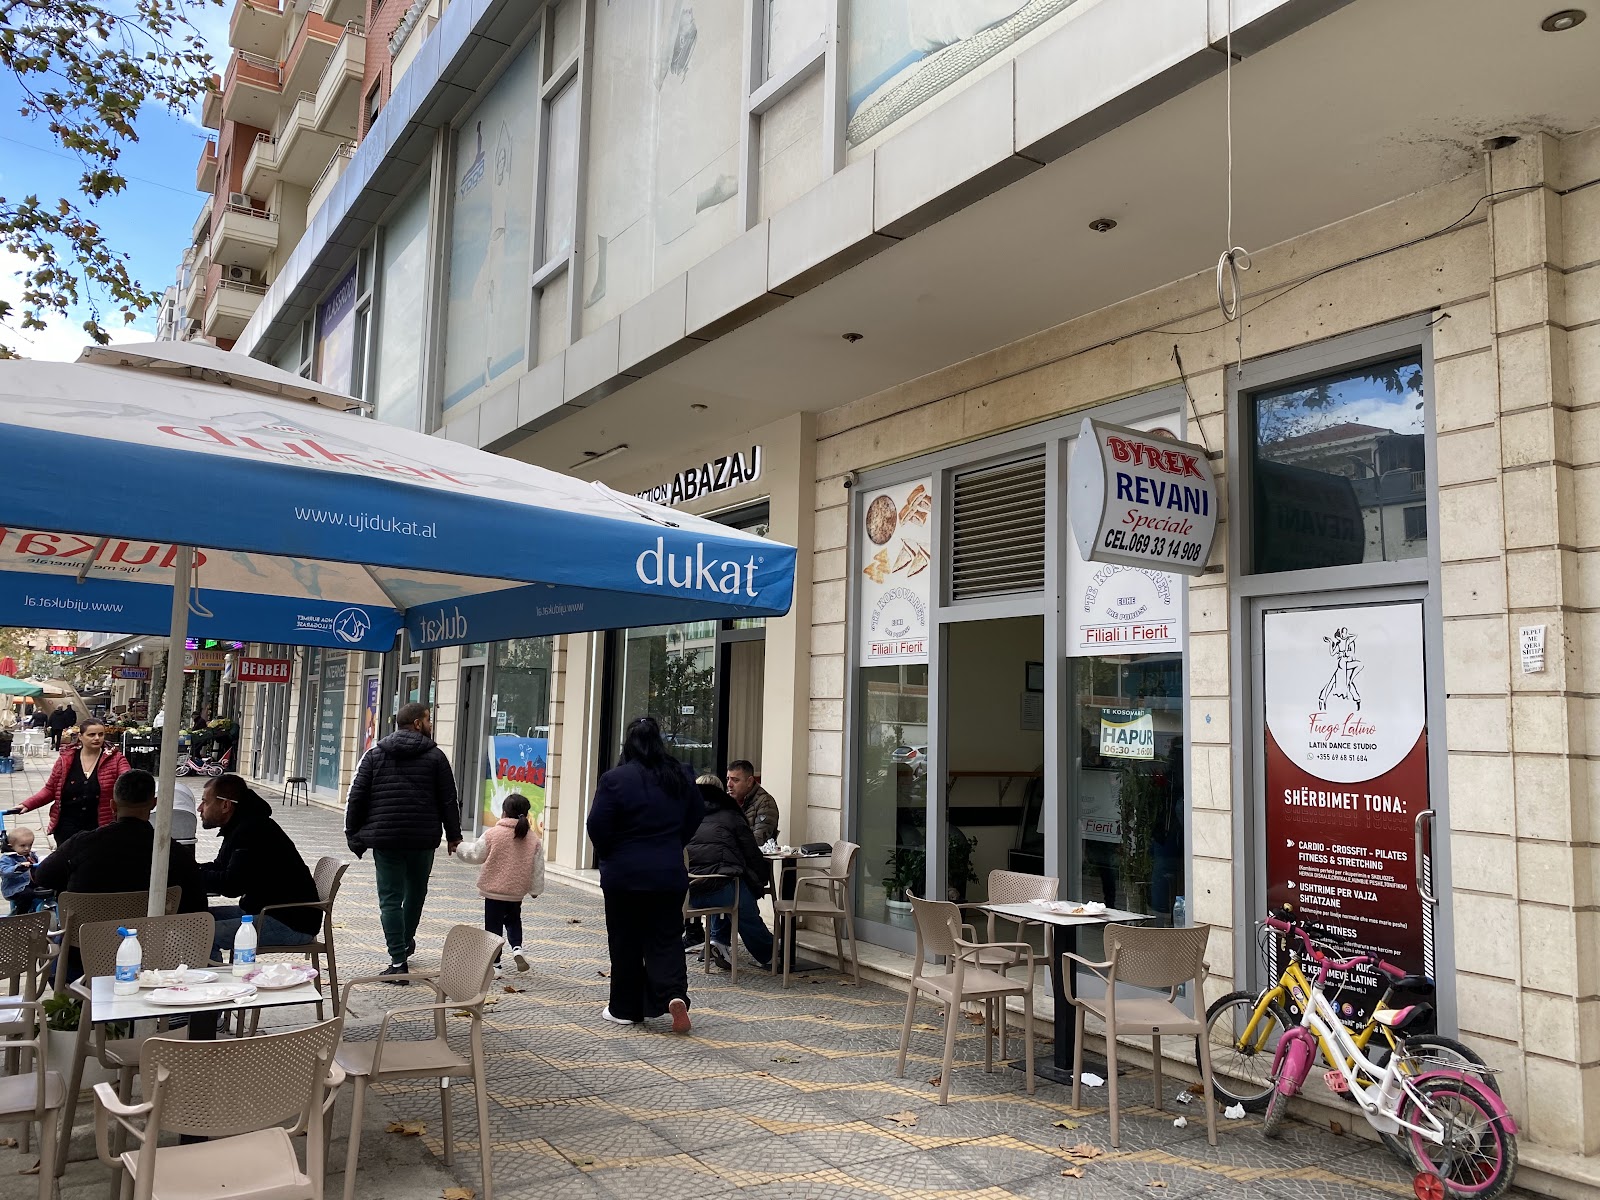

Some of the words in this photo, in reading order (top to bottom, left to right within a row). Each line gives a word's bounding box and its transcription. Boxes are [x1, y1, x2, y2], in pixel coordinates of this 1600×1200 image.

[1106, 436, 1206, 481] BYREK
[671, 445, 761, 505] ABAZAJ
[1116, 472, 1208, 516] REVANI
[294, 506, 437, 539] www.ujidukat.al
[1122, 509, 1193, 536] Speciale
[1105, 529, 1150, 553] CEL.069
[1151, 537, 1163, 555] 33
[1167, 539, 1181, 558] 14
[1181, 542, 1201, 561] 908
[1087, 627, 1119, 642] Filiali
[1124, 627, 1127, 640] i
[1133, 625, 1168, 639] Fierit
[872, 643, 893, 654] Filiali
[900, 641, 922, 653] Fierit
[241, 661, 288, 677] BERBER
[1103, 728, 1152, 745] HAPUR
[1309, 713, 1340, 741] Fuego
[1341, 713, 1376, 737] Latino
[1104, 745, 1129, 754] 06:30
[1285, 787, 1359, 809] SHËRBIMET
[1364, 795, 1407, 813] TONA:
[1299, 841, 1324, 851] CARDIO
[1332, 844, 1367, 856] CROSSFIT
[1375, 849, 1407, 861] PILATES
[1299, 853, 1328, 864] FITNESS
[1337, 857, 1383, 870] STRETCHING
[1300, 883, 1335, 896] USHTRIME
[1337, 888, 1352, 898] PER
[1354, 890, 1378, 901] VAJZA
[1300, 894, 1341, 908] SHTATZANE
[1326, 925, 1357, 938] FITNESS
[1302, 964, 1306, 972] E
[1351, 974, 1377, 987] LATINE
